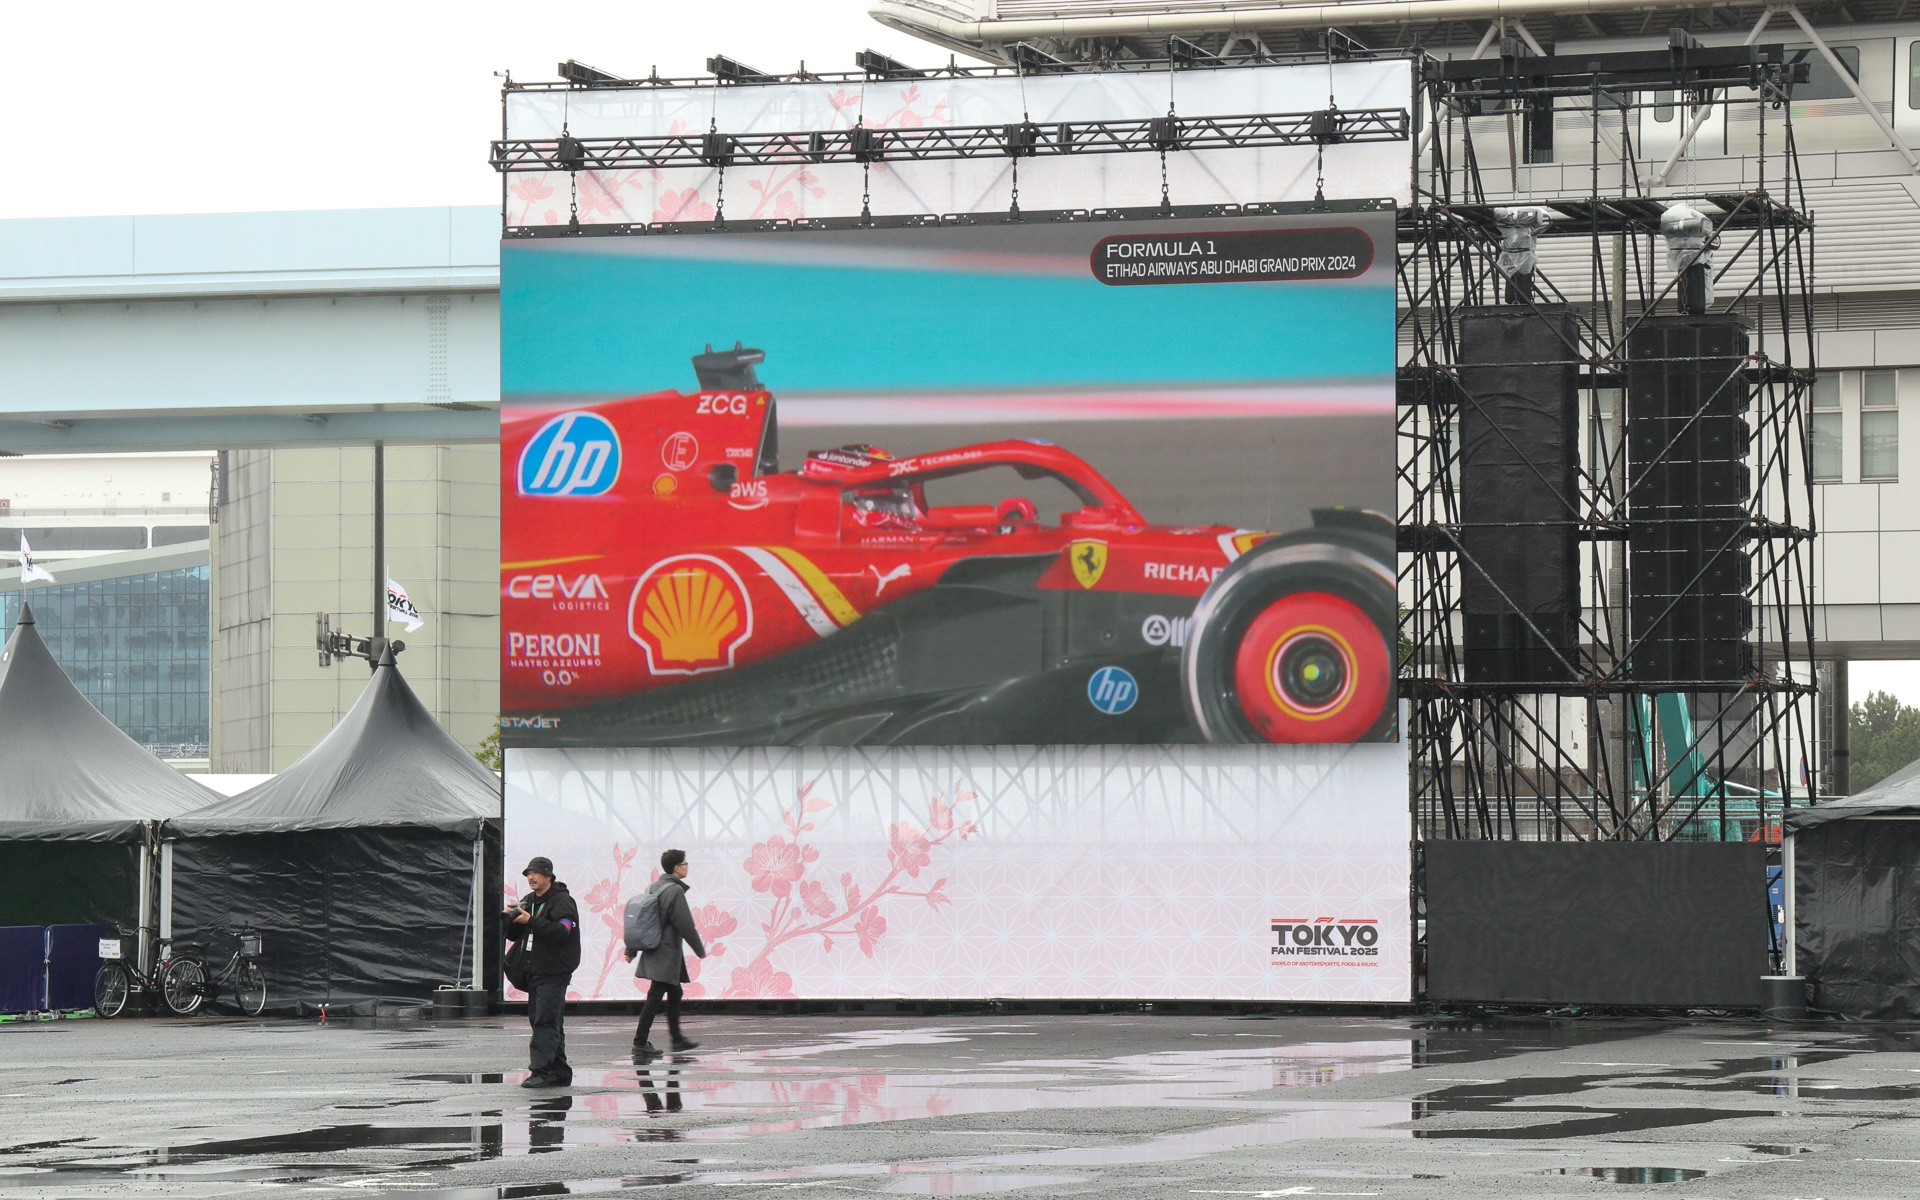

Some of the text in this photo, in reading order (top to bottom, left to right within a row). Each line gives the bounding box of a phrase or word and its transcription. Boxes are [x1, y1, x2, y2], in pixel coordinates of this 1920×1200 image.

[1106, 240, 1217, 258] FORMULA 1
[1106, 255, 1356, 278] ETIHAD AIRWAYS ABU DHABI GRAND PRIX 2024
[696, 394, 748, 415] ZCG
[529, 411, 613, 496] hp
[730, 480, 768, 498] aws
[552, 602, 610, 611] LOGISTICS
[507, 632, 601, 657] PERONI
[508, 659, 602, 668] NASTRO AZZURRO
[1094, 667, 1133, 714] hp
[1271, 925, 1378, 946] TOKYO
[1271, 947, 1378, 956] FAN FESTIVAL 2025
